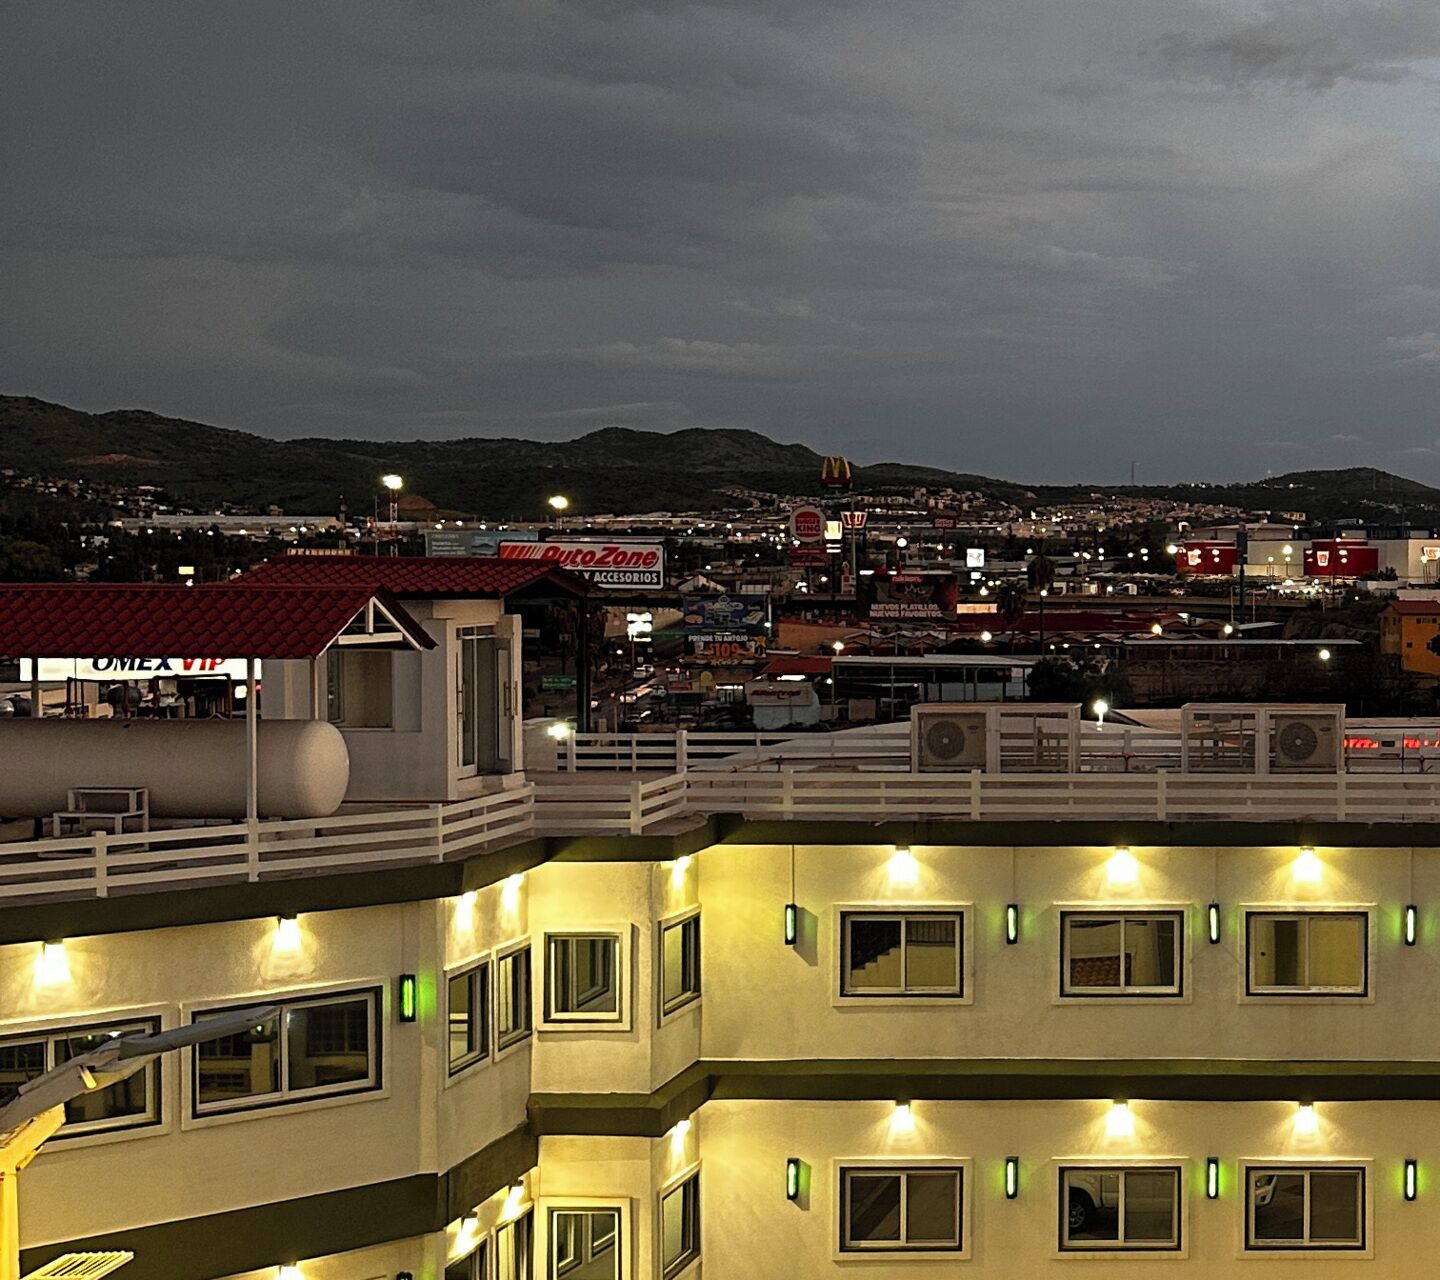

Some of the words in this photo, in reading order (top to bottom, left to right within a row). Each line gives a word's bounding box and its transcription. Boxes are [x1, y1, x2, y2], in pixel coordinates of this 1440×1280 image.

[542, 545, 659, 569] AutoZone
[593, 572, 658, 583] ACCESORIOS
[182, 658, 226, 671] VIP
